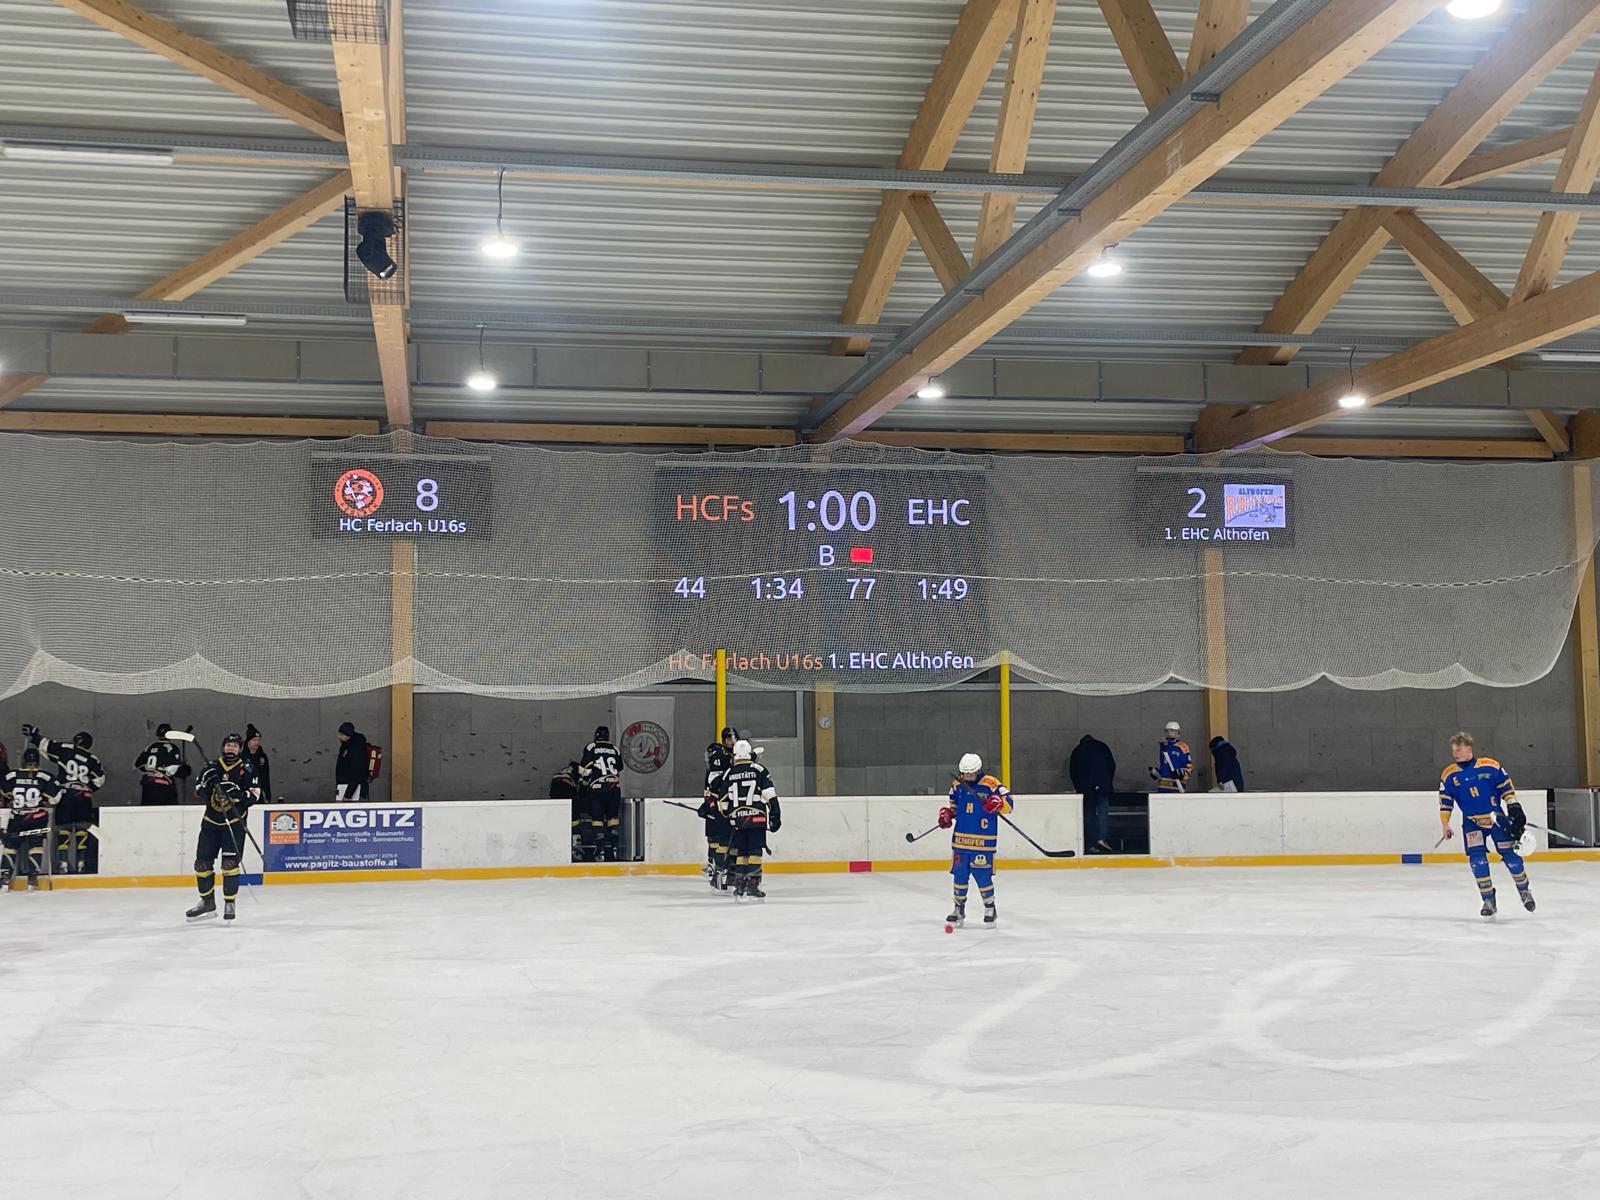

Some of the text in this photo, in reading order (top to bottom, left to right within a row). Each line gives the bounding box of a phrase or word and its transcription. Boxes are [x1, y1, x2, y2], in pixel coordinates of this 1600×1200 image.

[416, 478, 439, 511] 8
[1187, 487, 1206, 518] 2
[675, 494, 755, 521] HCFs
[778, 490, 877, 531] 1:00
[908, 499, 970, 525] EHC
[340, 518, 467, 533] HC Ferlach U16s
[1165, 527, 1270, 540] 1. EHC Althofen
[819, 545, 835, 566] B
[674, 577, 706, 598] 44
[752, 577, 804, 599] 1:34
[847, 578, 876, 599] 77
[918, 578, 968, 600] 1:49
[668, 652, 823, 670] HC Frlach U16s
[829, 650, 974, 669] 1. EHC Althofen
[728, 780, 756, 807] 17
[1470, 787, 1479, 797] H
[303, 810, 415, 829] PAGITZ
[285, 858, 398, 870] www.pagitz-baustoffe.at
